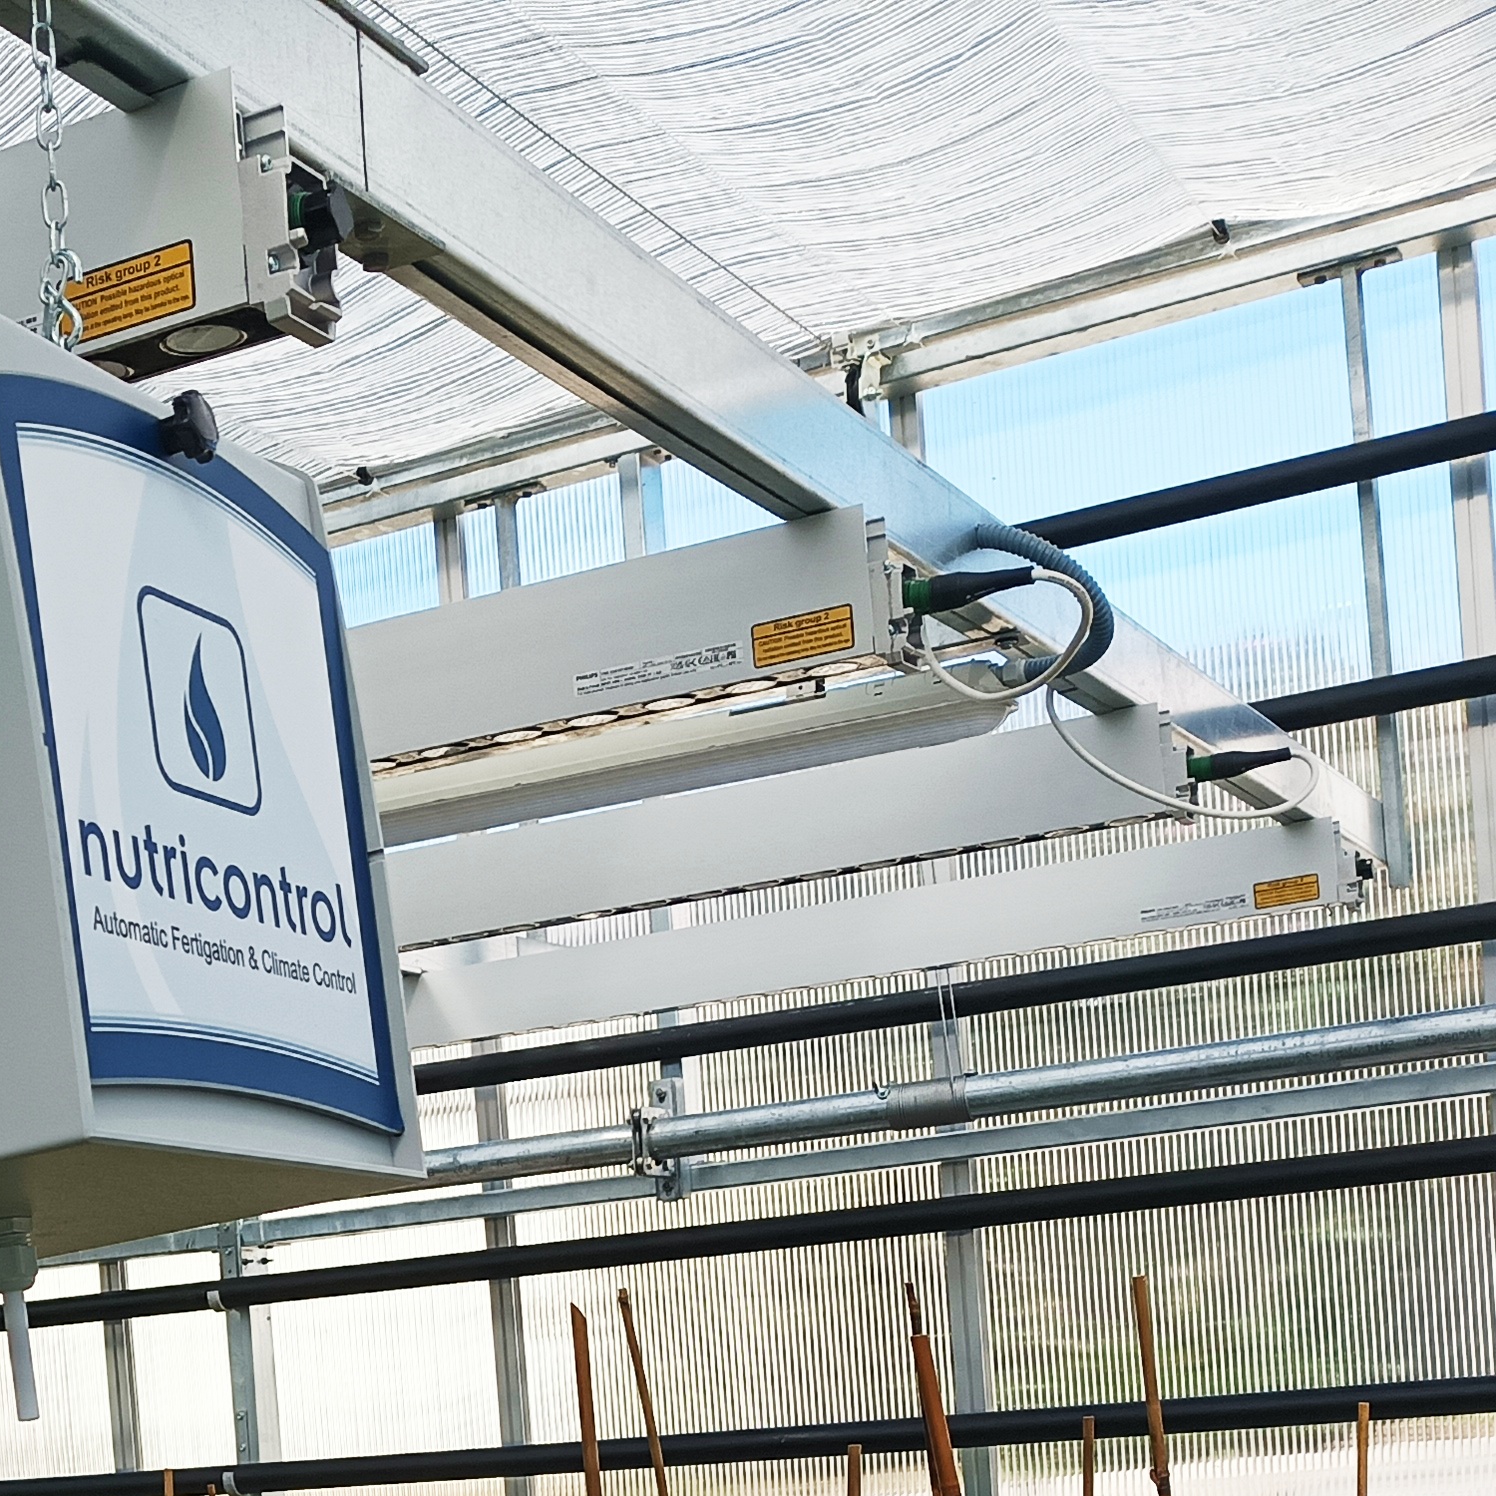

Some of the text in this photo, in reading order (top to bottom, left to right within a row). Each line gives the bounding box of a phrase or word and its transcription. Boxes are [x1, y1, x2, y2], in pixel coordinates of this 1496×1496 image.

[86, 255, 161, 289] Risk group 2
[773, 612, 829, 631] Risk group 2
[79, 819, 352, 948] nutricontrol
[93, 905, 357, 994] Automatic Fertigation & Climate Control
